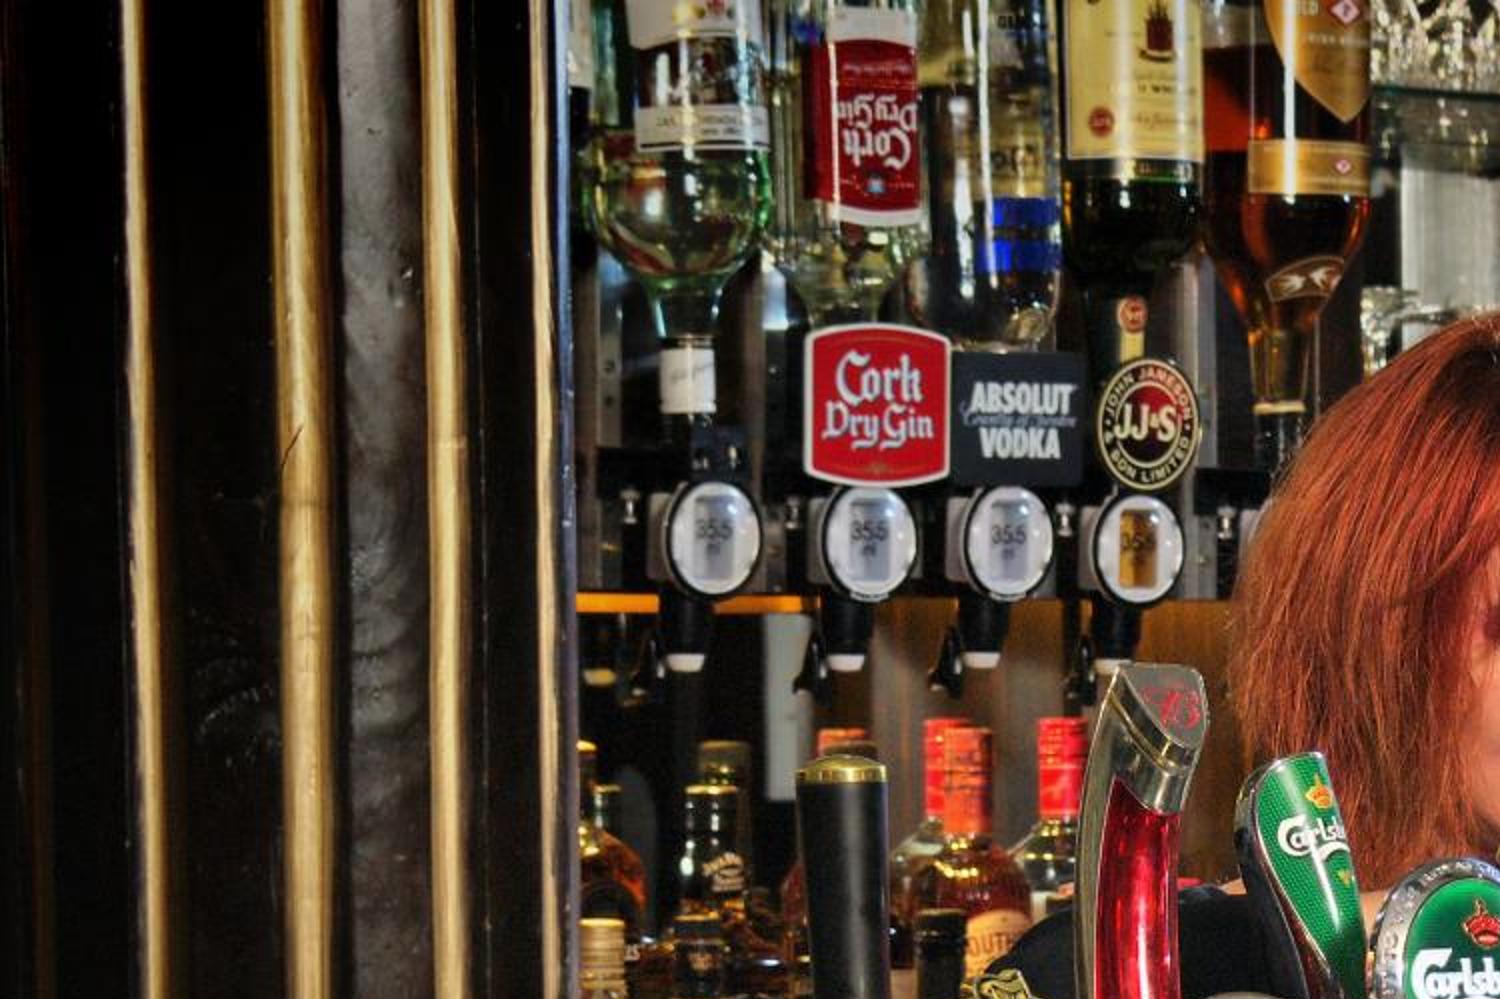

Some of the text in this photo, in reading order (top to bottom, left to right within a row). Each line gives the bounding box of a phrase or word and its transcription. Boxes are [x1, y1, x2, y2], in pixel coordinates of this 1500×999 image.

[841, 125, 912, 170] Cork
[836, 349, 926, 407] Cork
[971, 381, 1078, 415] ABSOLUT
[1105, 366, 1192, 421] JOHN JAMESON
[821, 402, 935, 449] Dry Gin
[980, 428, 1061, 459] VODKA
[1113, 402, 1177, 442] JJ&S
[1110, 450, 1138, 480] SON
[1140, 436, 1190, 483] LIMITED
[1277, 814, 1349, 857] Carlsb
